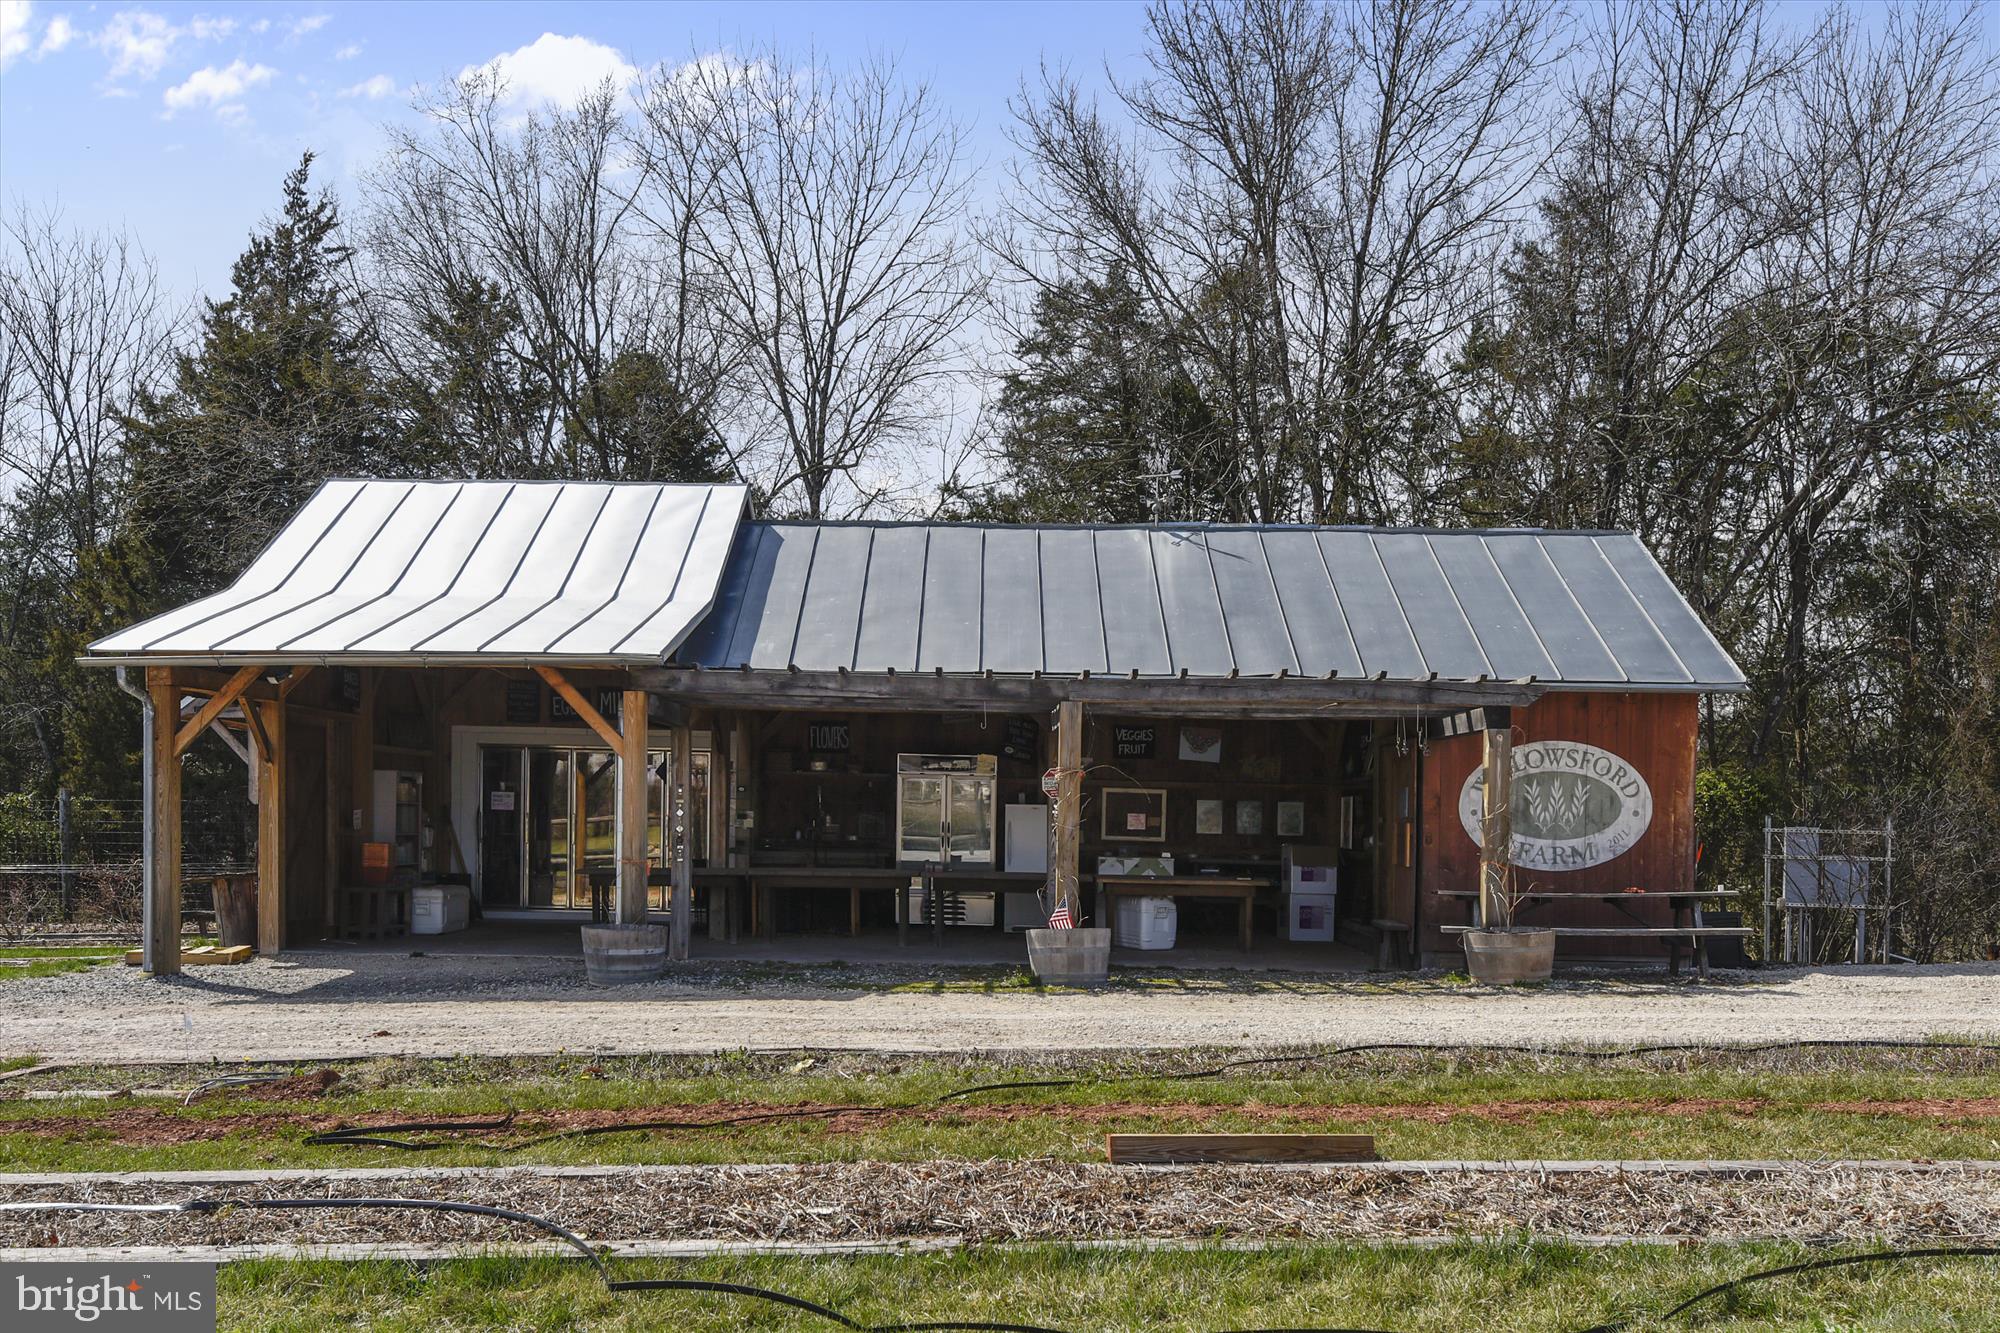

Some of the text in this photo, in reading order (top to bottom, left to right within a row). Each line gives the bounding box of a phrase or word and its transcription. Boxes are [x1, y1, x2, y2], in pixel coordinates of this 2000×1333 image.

[809, 726, 849, 749] FLOWERS
[1115, 727, 1154, 742] VEGGIES
[1118, 743, 1146, 756] FRUIT
[1516, 841, 1596, 865] FARM
